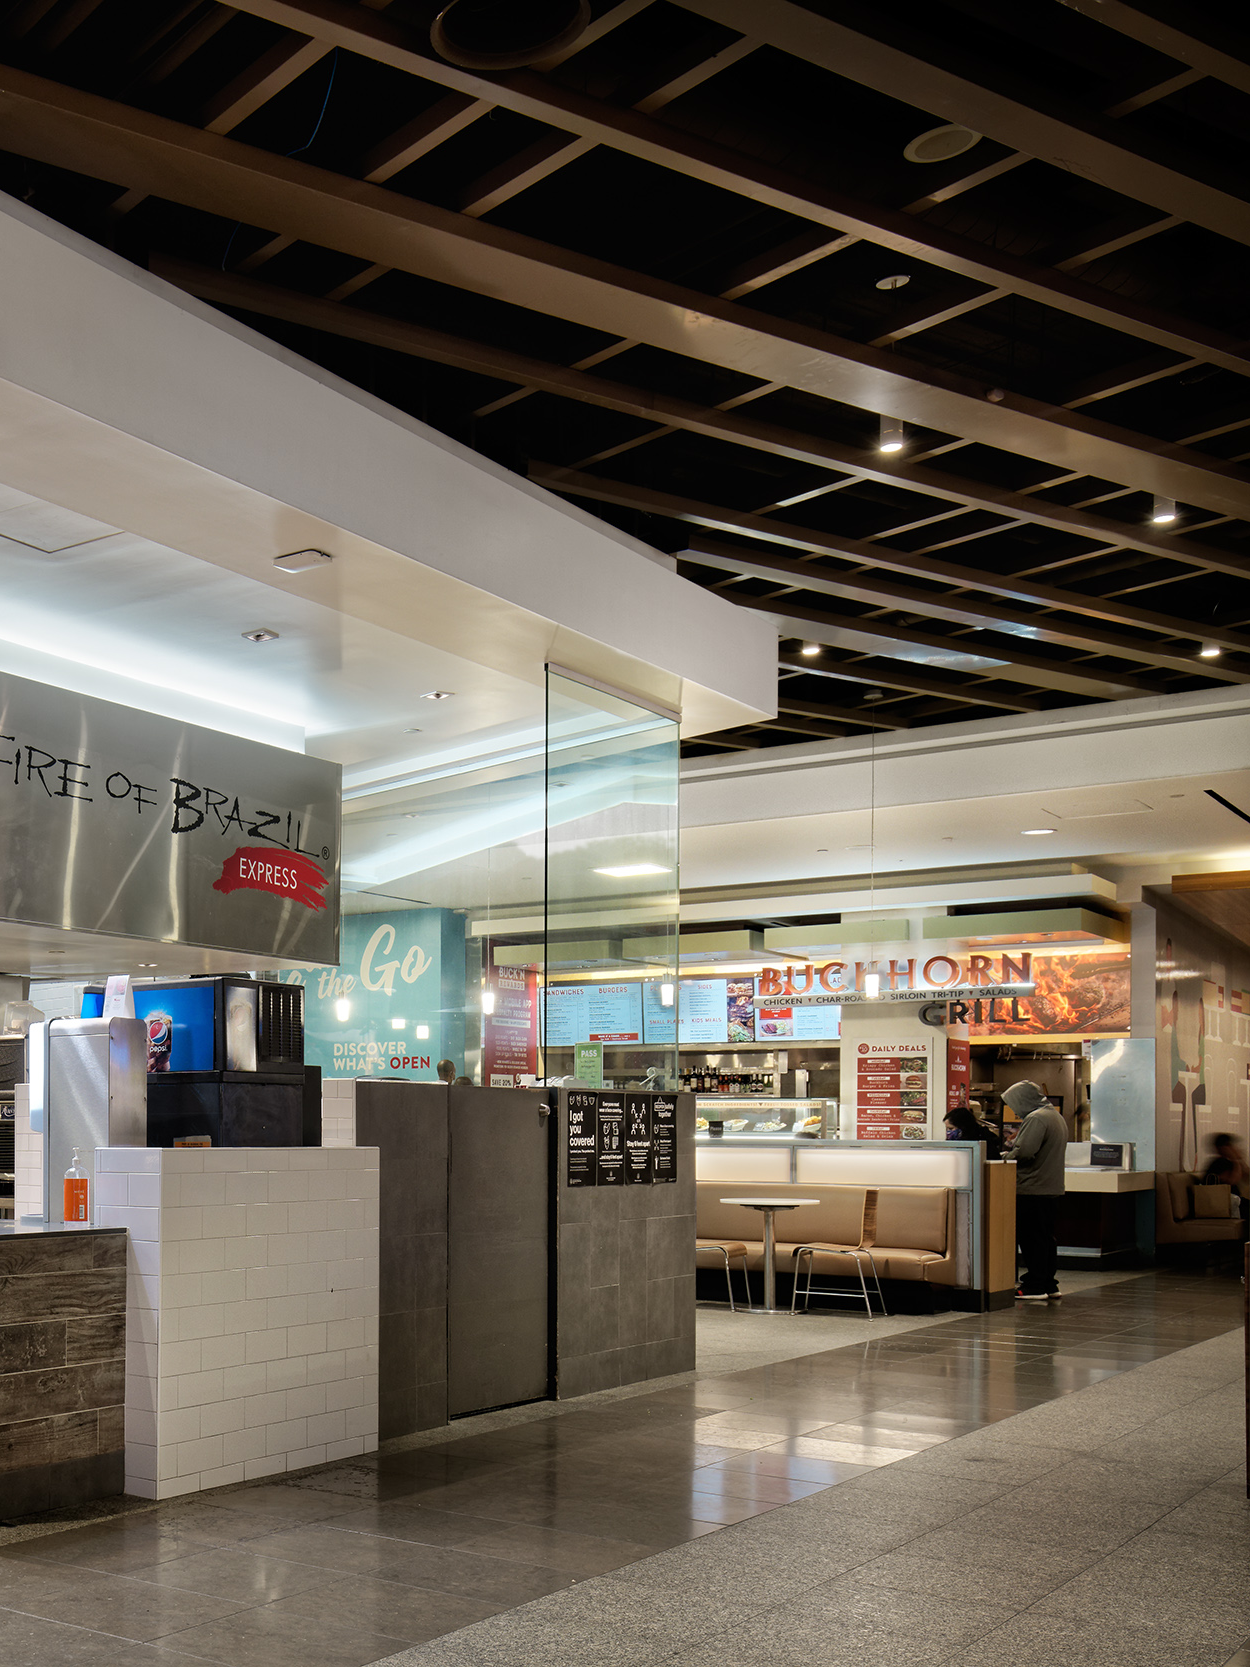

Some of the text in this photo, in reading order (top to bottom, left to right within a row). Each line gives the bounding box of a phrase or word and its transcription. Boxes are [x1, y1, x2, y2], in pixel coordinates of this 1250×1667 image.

[106, 772, 157, 814] OF
[170, 778, 320, 857] BRAZIL
[239, 857, 298, 890] EXPRESS
[360, 924, 432, 996] Go
[499, 967, 525, 980] BUCK'N
[318, 968, 357, 999] the
[918, 1002, 1030, 1026] GRILL
[150, 1045, 167, 1053] pepsi
[333, 1041, 406, 1056] DISCOVER
[581, 1050, 598, 1058] PASS
[333, 1056, 430, 1070] WHAT'S OPEN
[573, 1111, 583, 1124] got
[570, 1125, 582, 1136] you
[570, 1135, 595, 1146] covered
